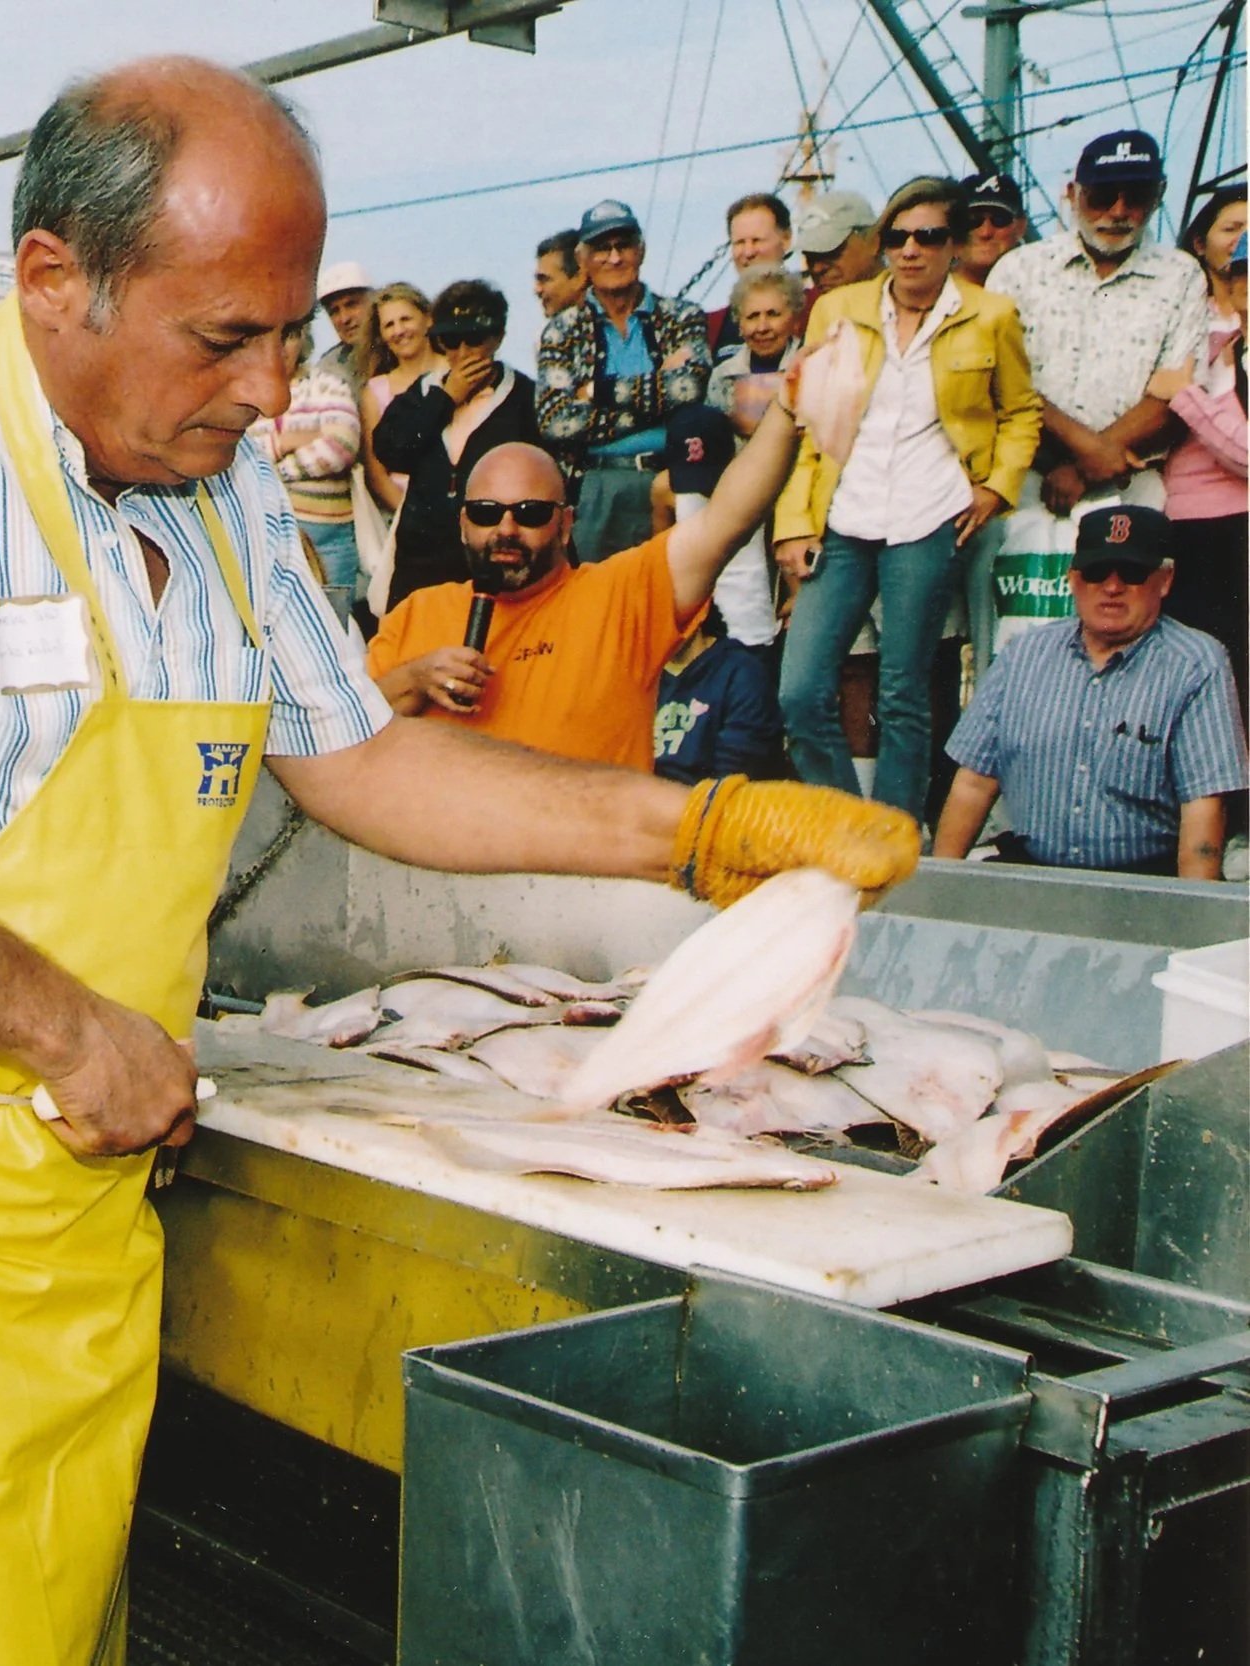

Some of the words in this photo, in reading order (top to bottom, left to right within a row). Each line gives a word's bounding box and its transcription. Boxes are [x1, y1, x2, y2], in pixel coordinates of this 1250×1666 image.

[975, 175, 1000, 192] A
[684, 437, 704, 462] B
[1105, 514, 1132, 543] B
